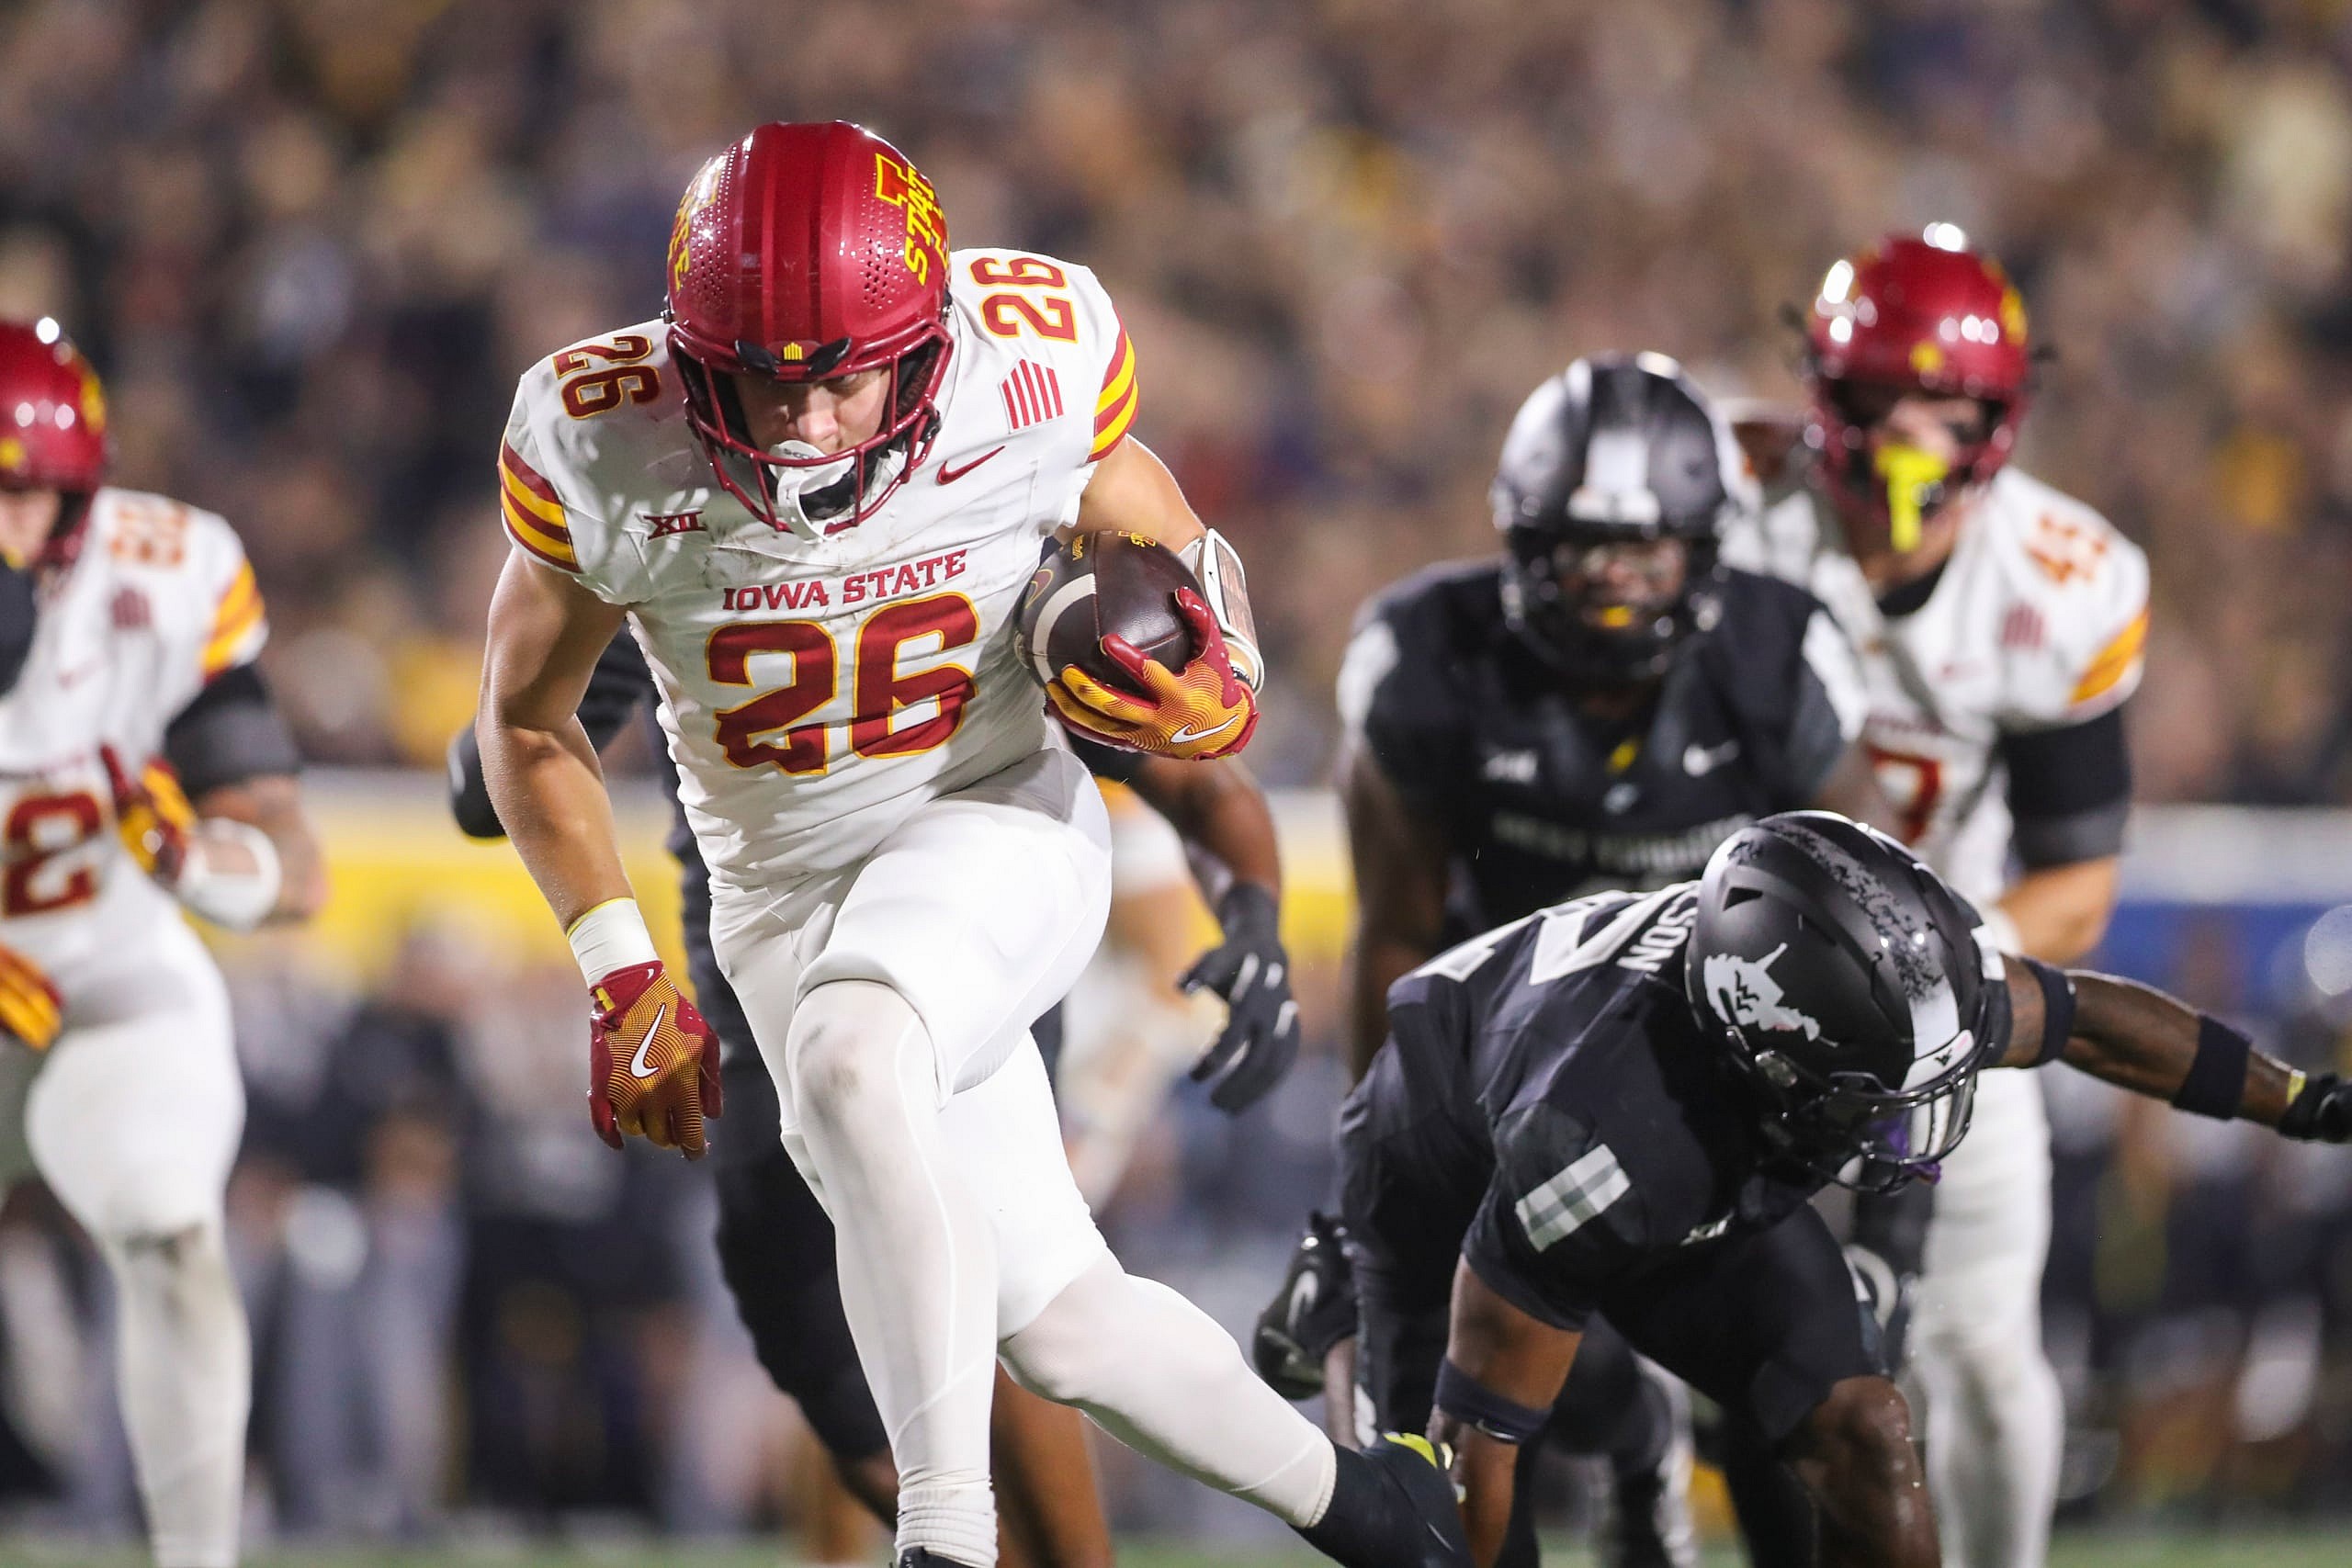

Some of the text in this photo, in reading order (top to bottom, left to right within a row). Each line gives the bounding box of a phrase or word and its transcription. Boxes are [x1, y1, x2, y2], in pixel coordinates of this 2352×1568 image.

[904, 165, 934, 286] STAT
[969, 256, 1079, 344] 26
[551, 334, 662, 421] 26
[643, 511, 707, 540] XII
[722, 549, 967, 611] IOWA STATE
[705, 592, 980, 775] 26
[1617, 886, 1698, 973] SON
